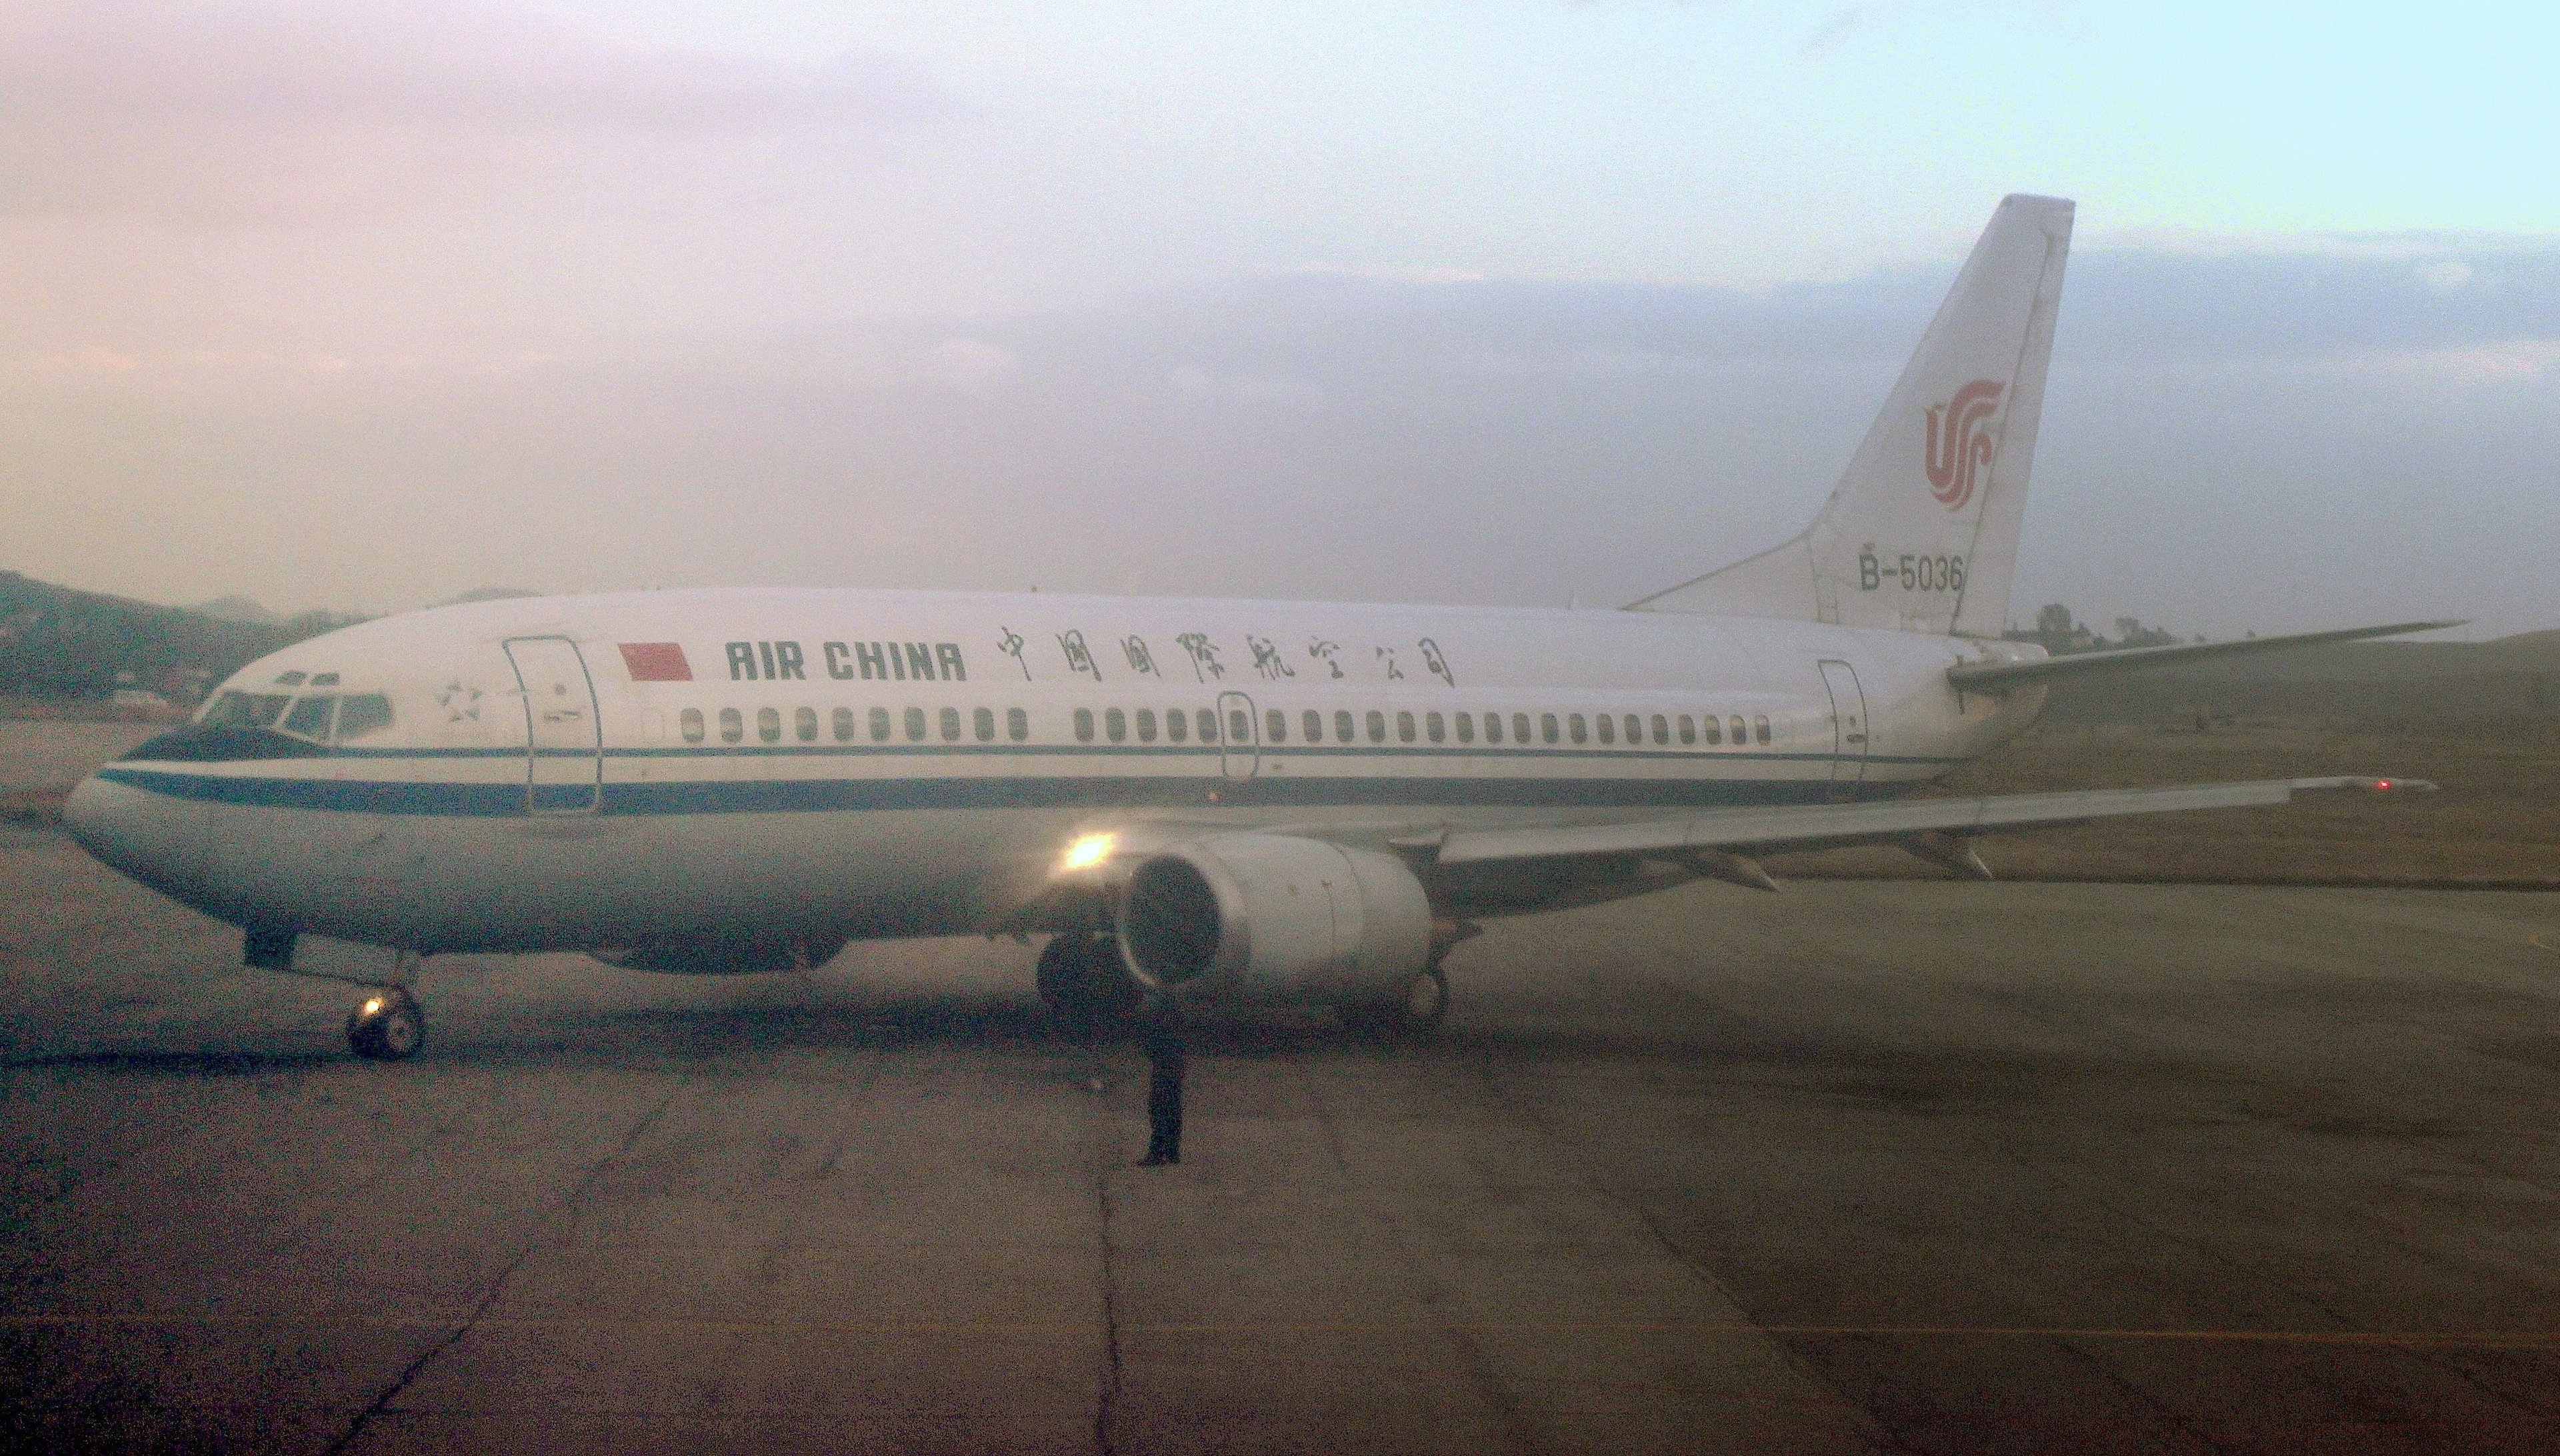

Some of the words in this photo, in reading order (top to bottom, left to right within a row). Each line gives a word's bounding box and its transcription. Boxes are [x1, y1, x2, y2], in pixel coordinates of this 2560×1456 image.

[1859, 554, 1963, 591] B-5036
[725, 641, 806, 681] AIR
[823, 641, 967, 681] CHINA
